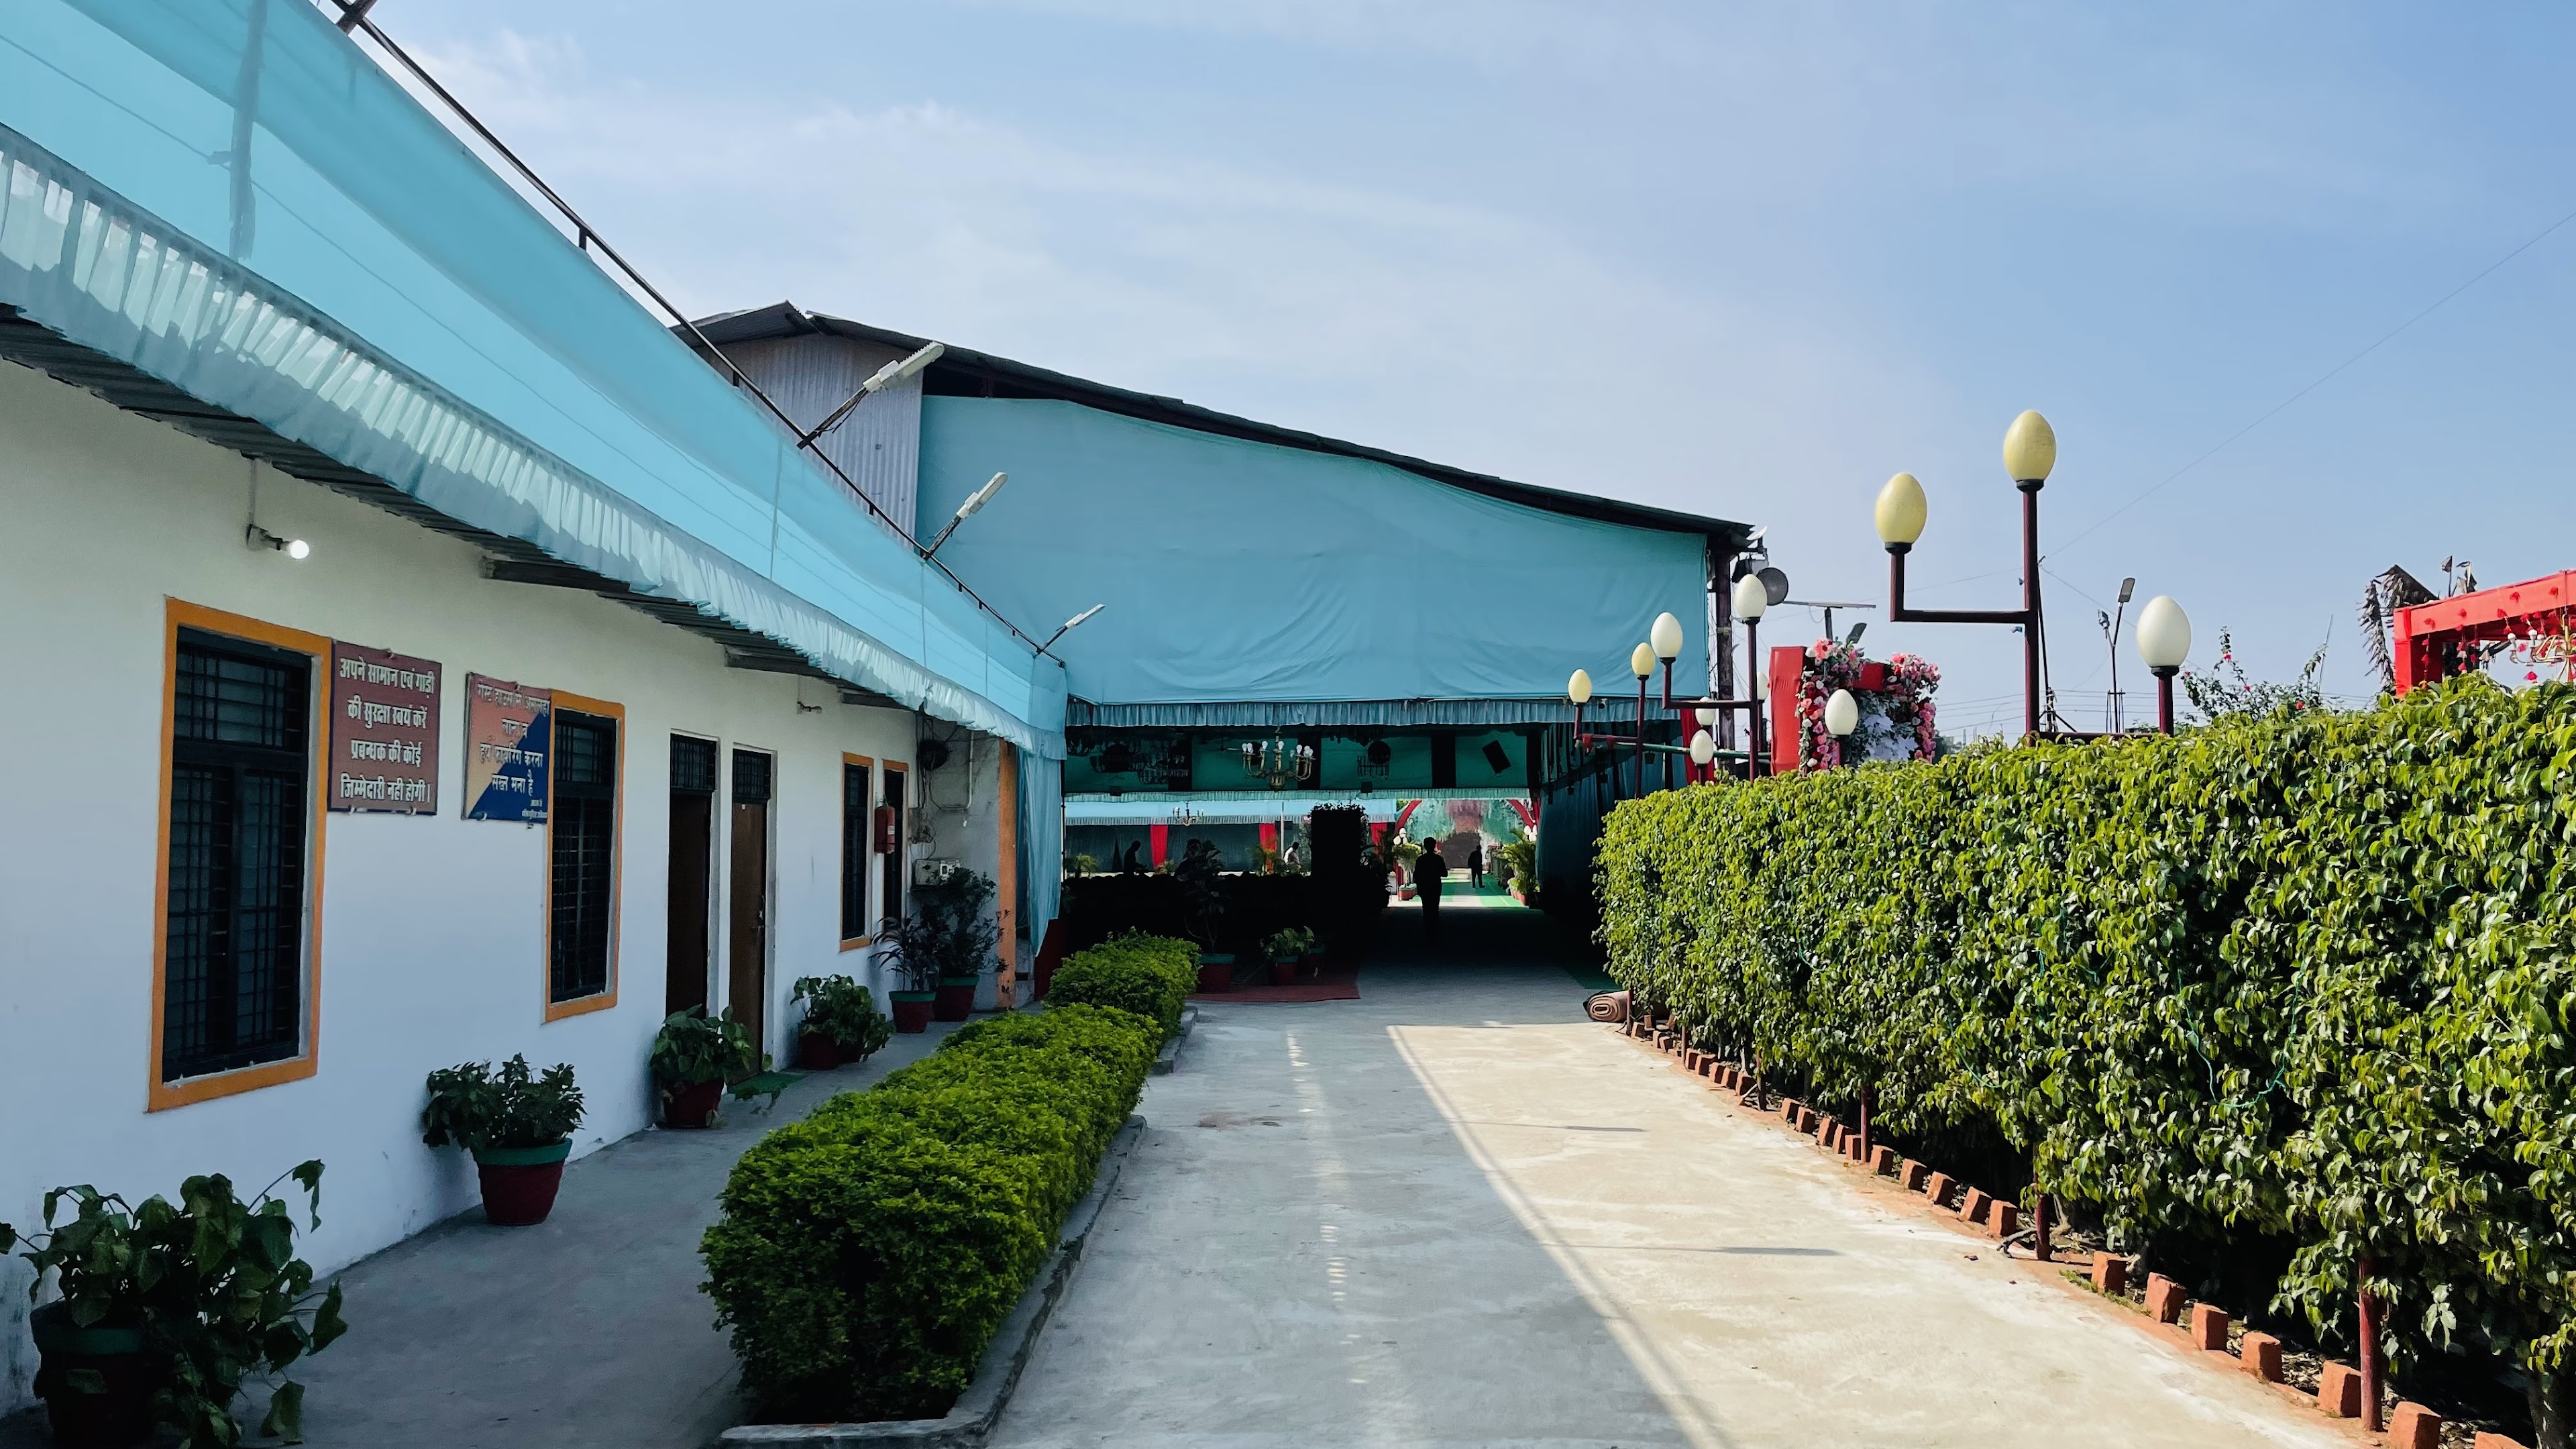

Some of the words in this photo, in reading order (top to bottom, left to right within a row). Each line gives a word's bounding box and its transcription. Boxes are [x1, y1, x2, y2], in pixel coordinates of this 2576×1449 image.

[339, 655, 366, 682] अपने
[368, 663, 399, 688] सामान
[400, 667, 414, 690] एवं
[415, 671, 435, 699] गाड़ी
[347, 694, 362, 720] की
[364, 702, 392, 729] सुरक्षा
[392, 704, 412, 727] स्वयं
[413, 705, 427, 729] करें
[350, 739, 387, 761] प्रबन्धक
[388, 739, 402, 763] की
[402, 741, 422, 768] कोई
[524, 751, 543, 768] करना
[340, 773, 386, 800] जिम्मेदारी
[511, 776, 526, 794] मना
[527, 769, 534, 797] है
